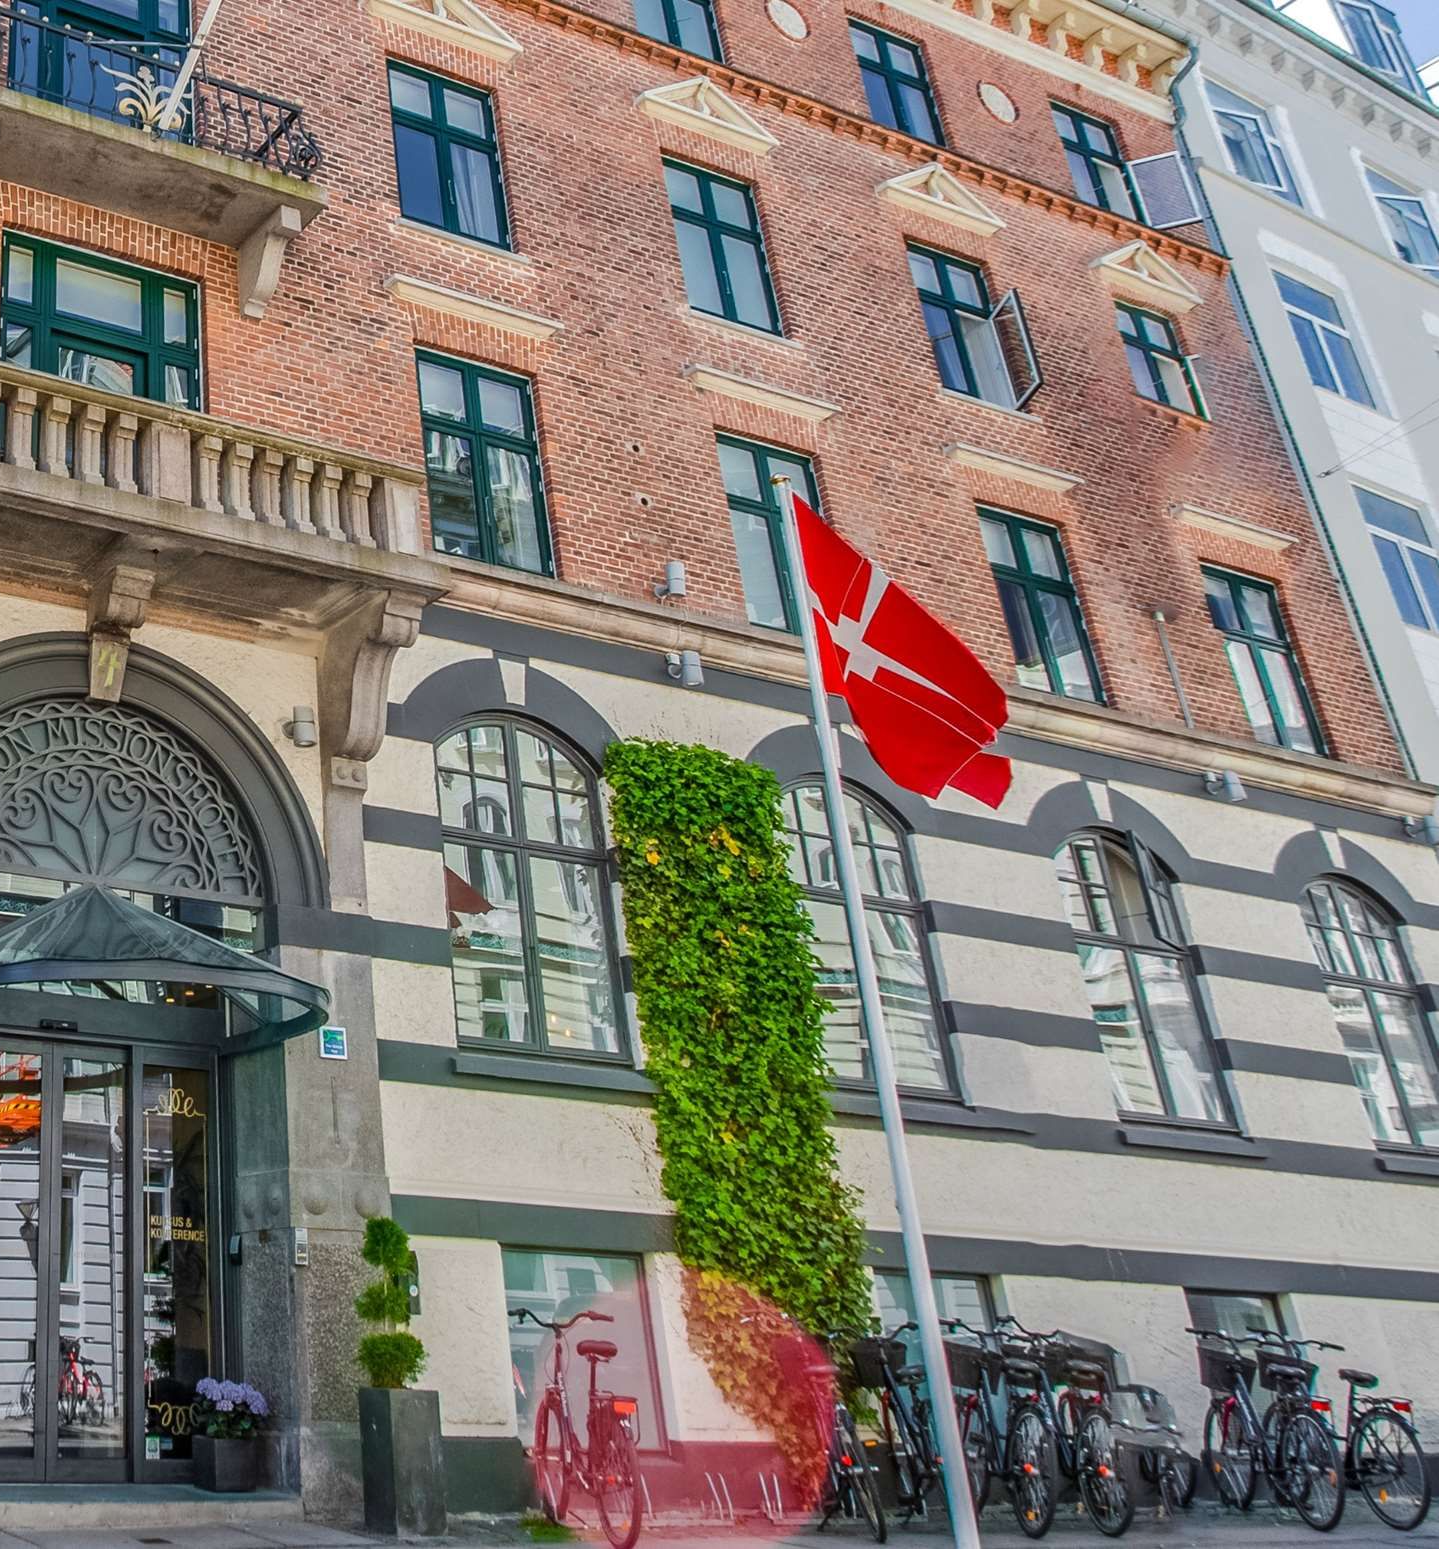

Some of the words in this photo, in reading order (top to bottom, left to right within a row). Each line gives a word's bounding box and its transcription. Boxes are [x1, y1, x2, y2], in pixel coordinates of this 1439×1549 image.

[150, 1214, 184, 1228] KUUS
[185, 1217, 193, 1228] &
[150, 1228, 205, 1242] KOERENCE
